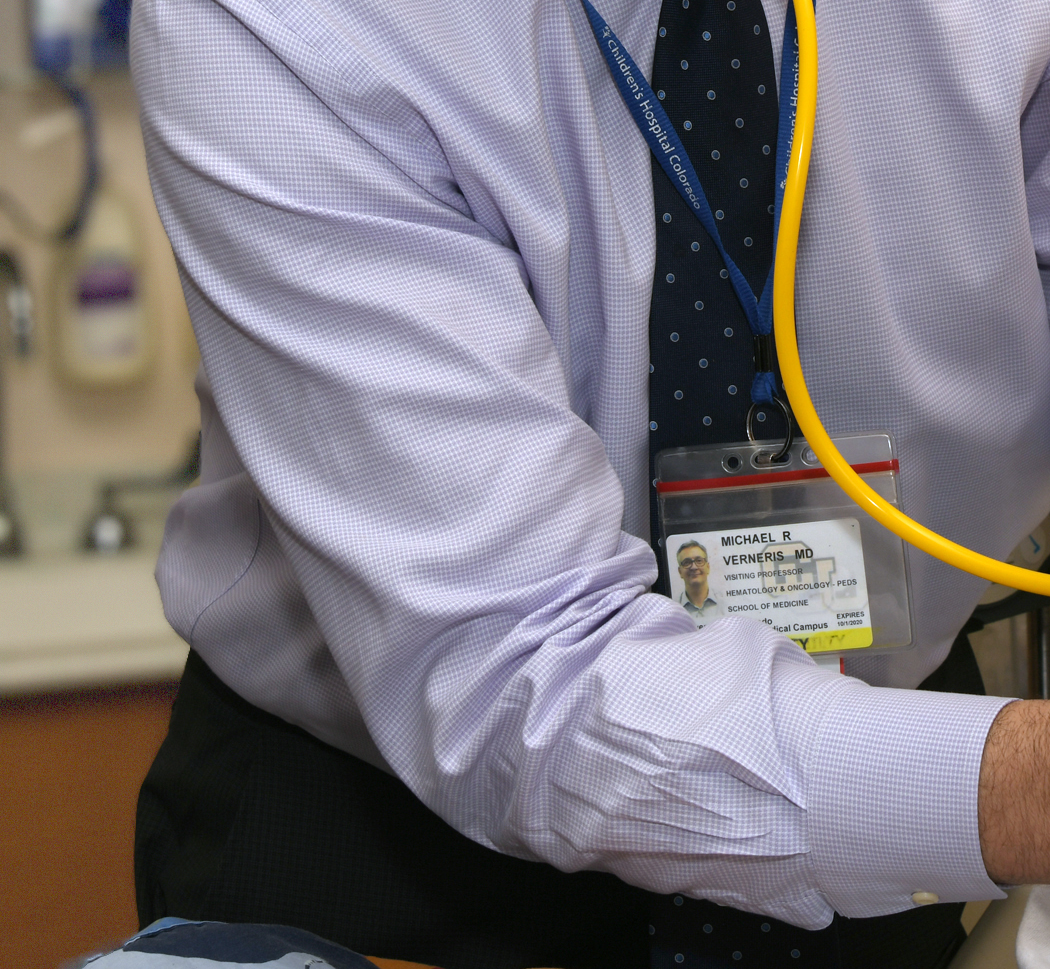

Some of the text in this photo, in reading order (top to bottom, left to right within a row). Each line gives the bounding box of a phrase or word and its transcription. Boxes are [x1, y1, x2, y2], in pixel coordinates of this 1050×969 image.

[607, 39, 700, 210] Children's Hospital Colorado
[721, 531, 792, 547] MICHAEL R
[723, 548, 814, 566] VERNERIS MD
[724, 568, 803, 581] VISITING PROFESSOR
[726, 586, 778, 597] HEMATOLOGY
[787, 581, 831, 592] ONCOLOGY
[837, 579, 858, 587] PEDS
[727, 599, 809, 613] SCHOOL OF MEDICINE
[836, 611, 865, 620] EXPIRES
[793, 621, 829, 632] Campus
[837, 619, 863, 627] 10/1/2020
